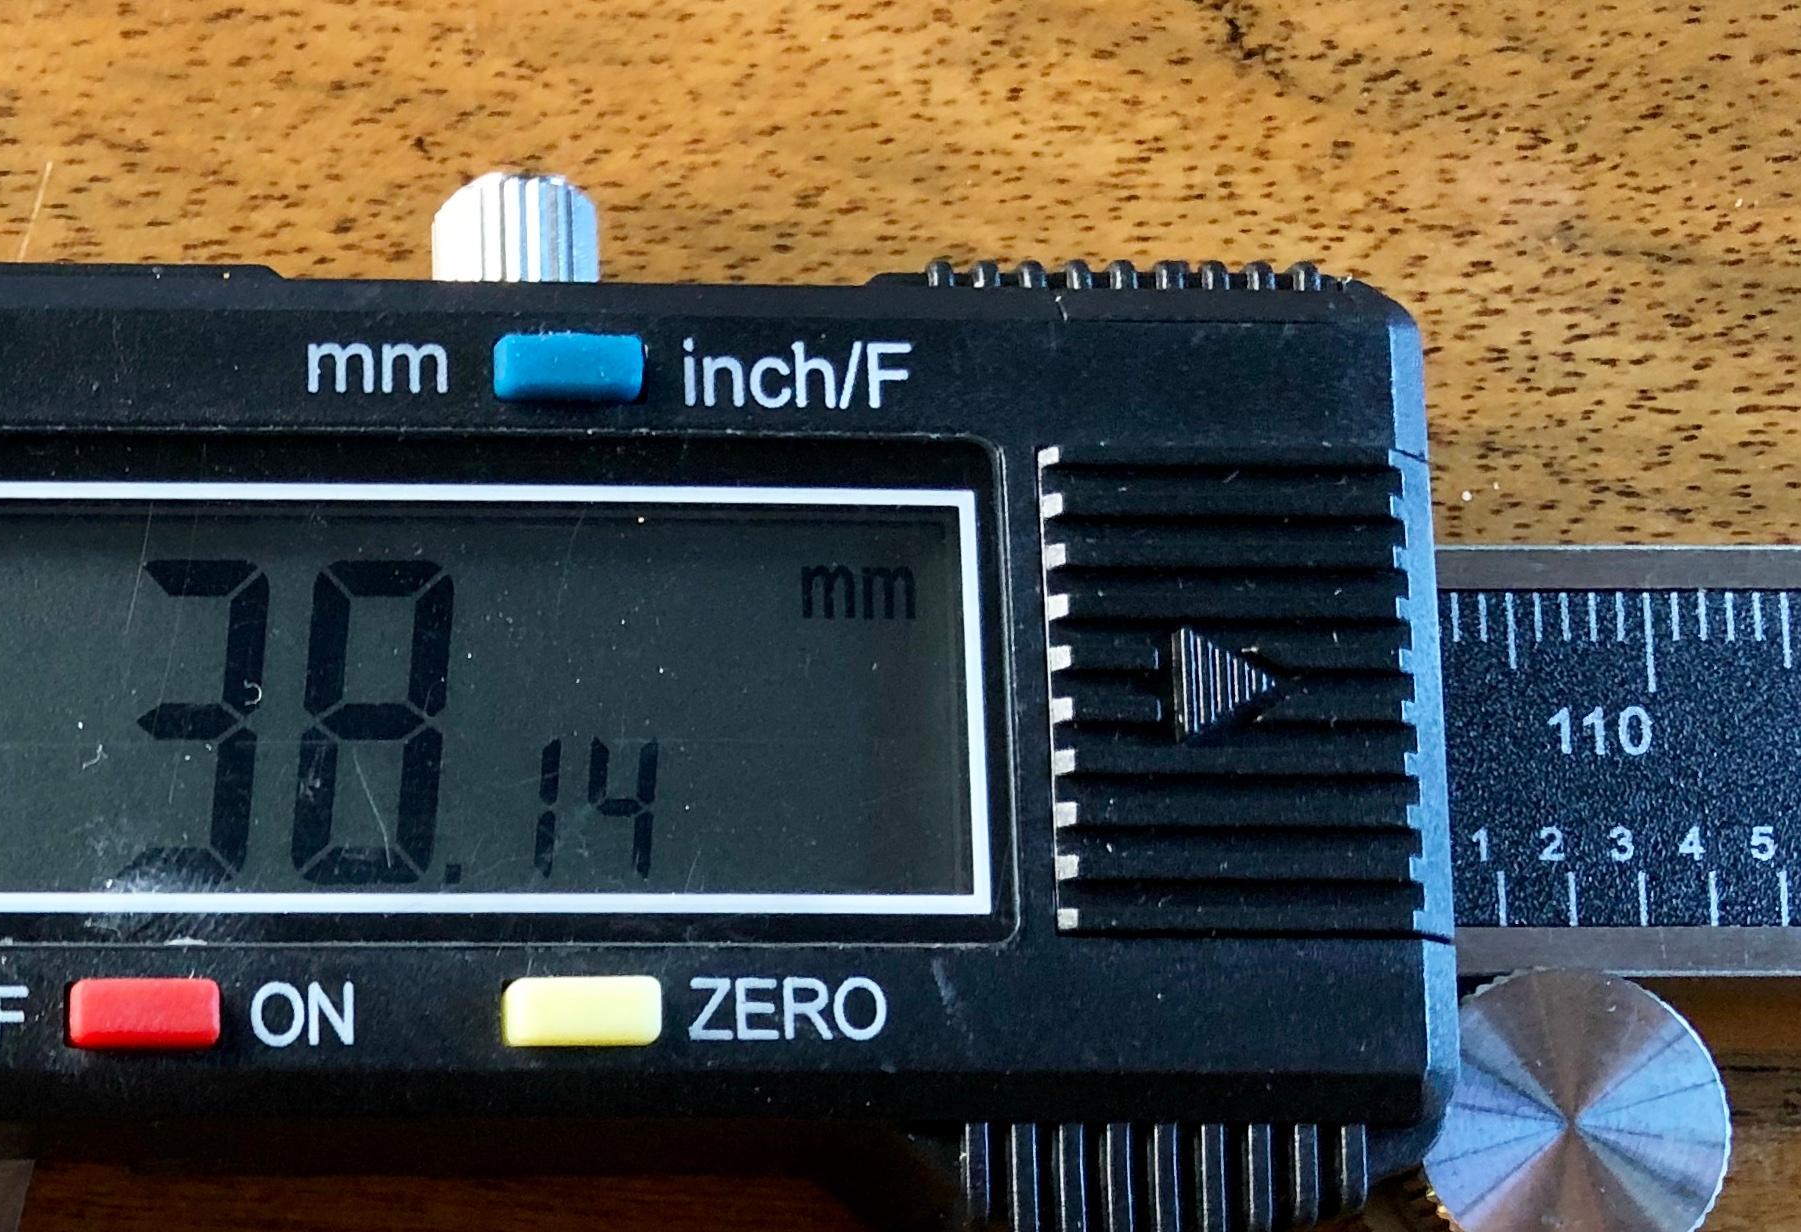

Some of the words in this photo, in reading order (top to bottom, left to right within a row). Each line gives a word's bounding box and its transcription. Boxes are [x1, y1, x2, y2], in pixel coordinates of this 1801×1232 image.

[308, 343, 447, 393] mm
[683, 338, 911, 409] inch/F
[801, 565, 916, 620] mm
[114, 558, 659, 886] 38.14
[1548, 706, 1653, 755] 110
[1472, 828, 1488, 861] 1
[1539, 826, 1565, 861] 2
[1607, 825, 1634, 862] 3
[1679, 825, 1705, 860] 4
[1751, 826, 1777, 861] 5
[251, 981, 354, 1046] ON
[689, 977, 886, 1040] ZERO
